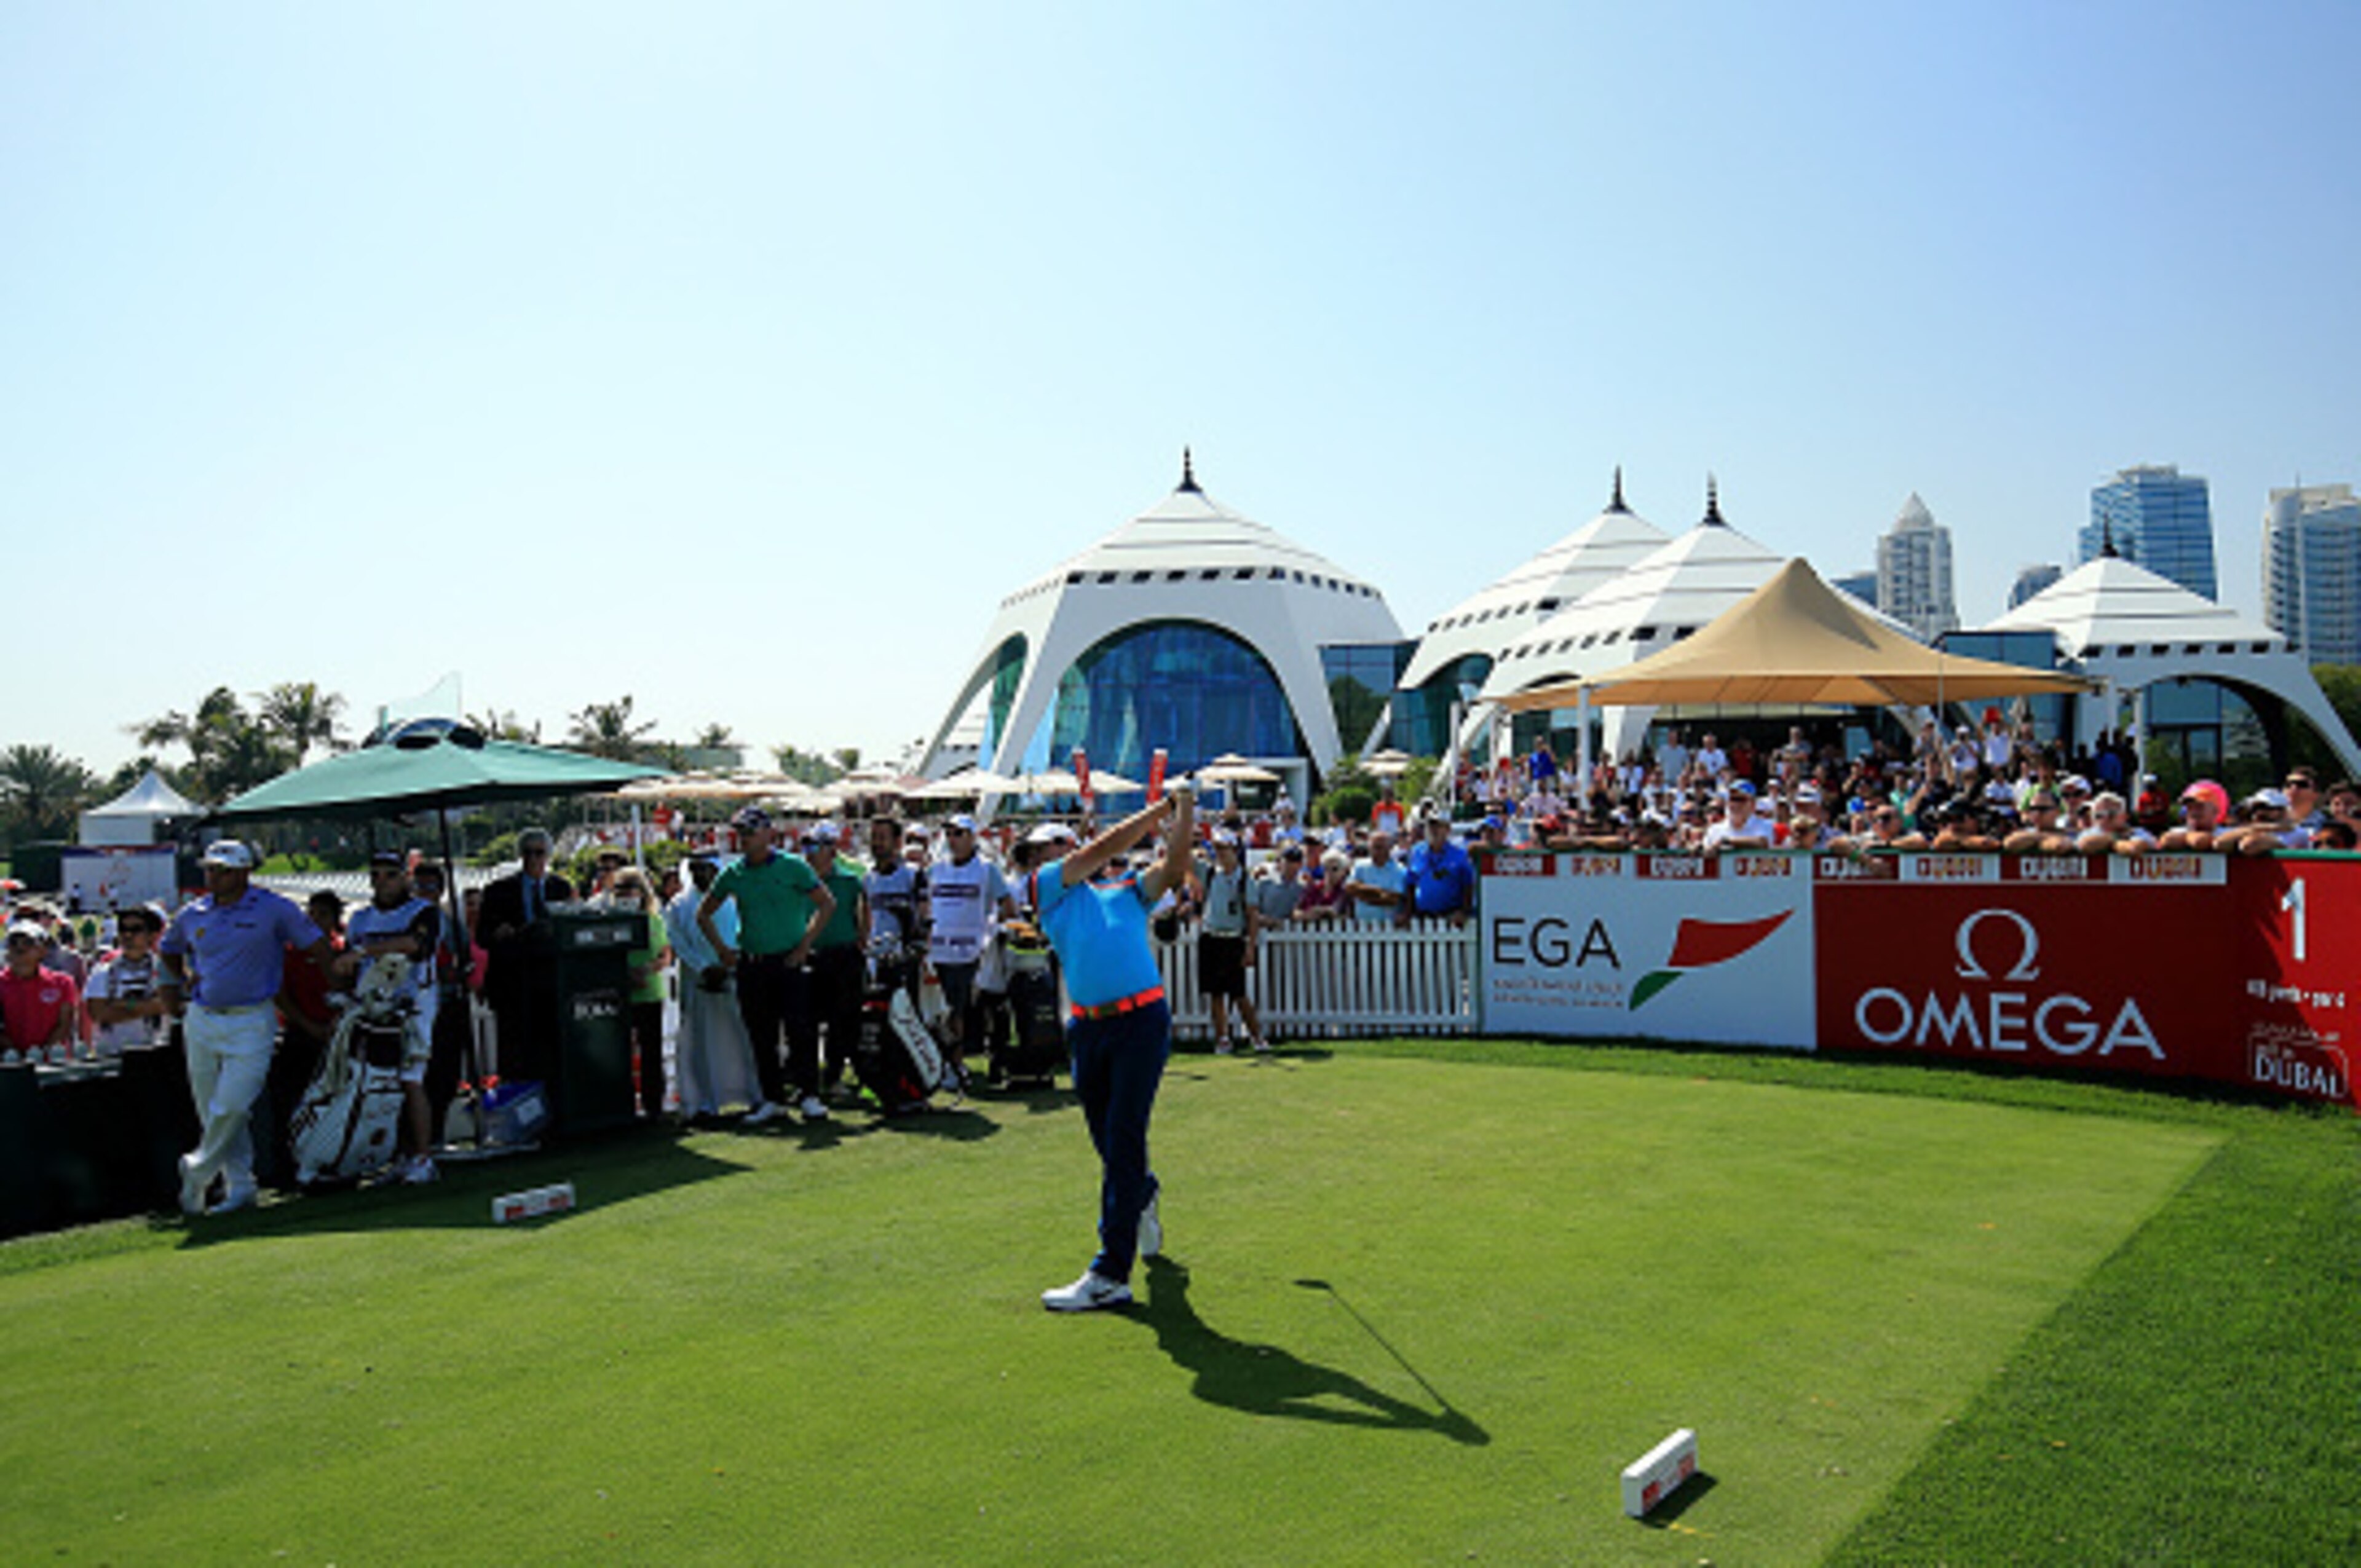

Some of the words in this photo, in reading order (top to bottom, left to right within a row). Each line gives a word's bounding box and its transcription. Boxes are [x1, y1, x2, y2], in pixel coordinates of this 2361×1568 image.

[1493, 918, 1620, 969] EGA
[2281, 877, 2306, 960] 1
[1855, 987, 2165, 1060] OMEGA
